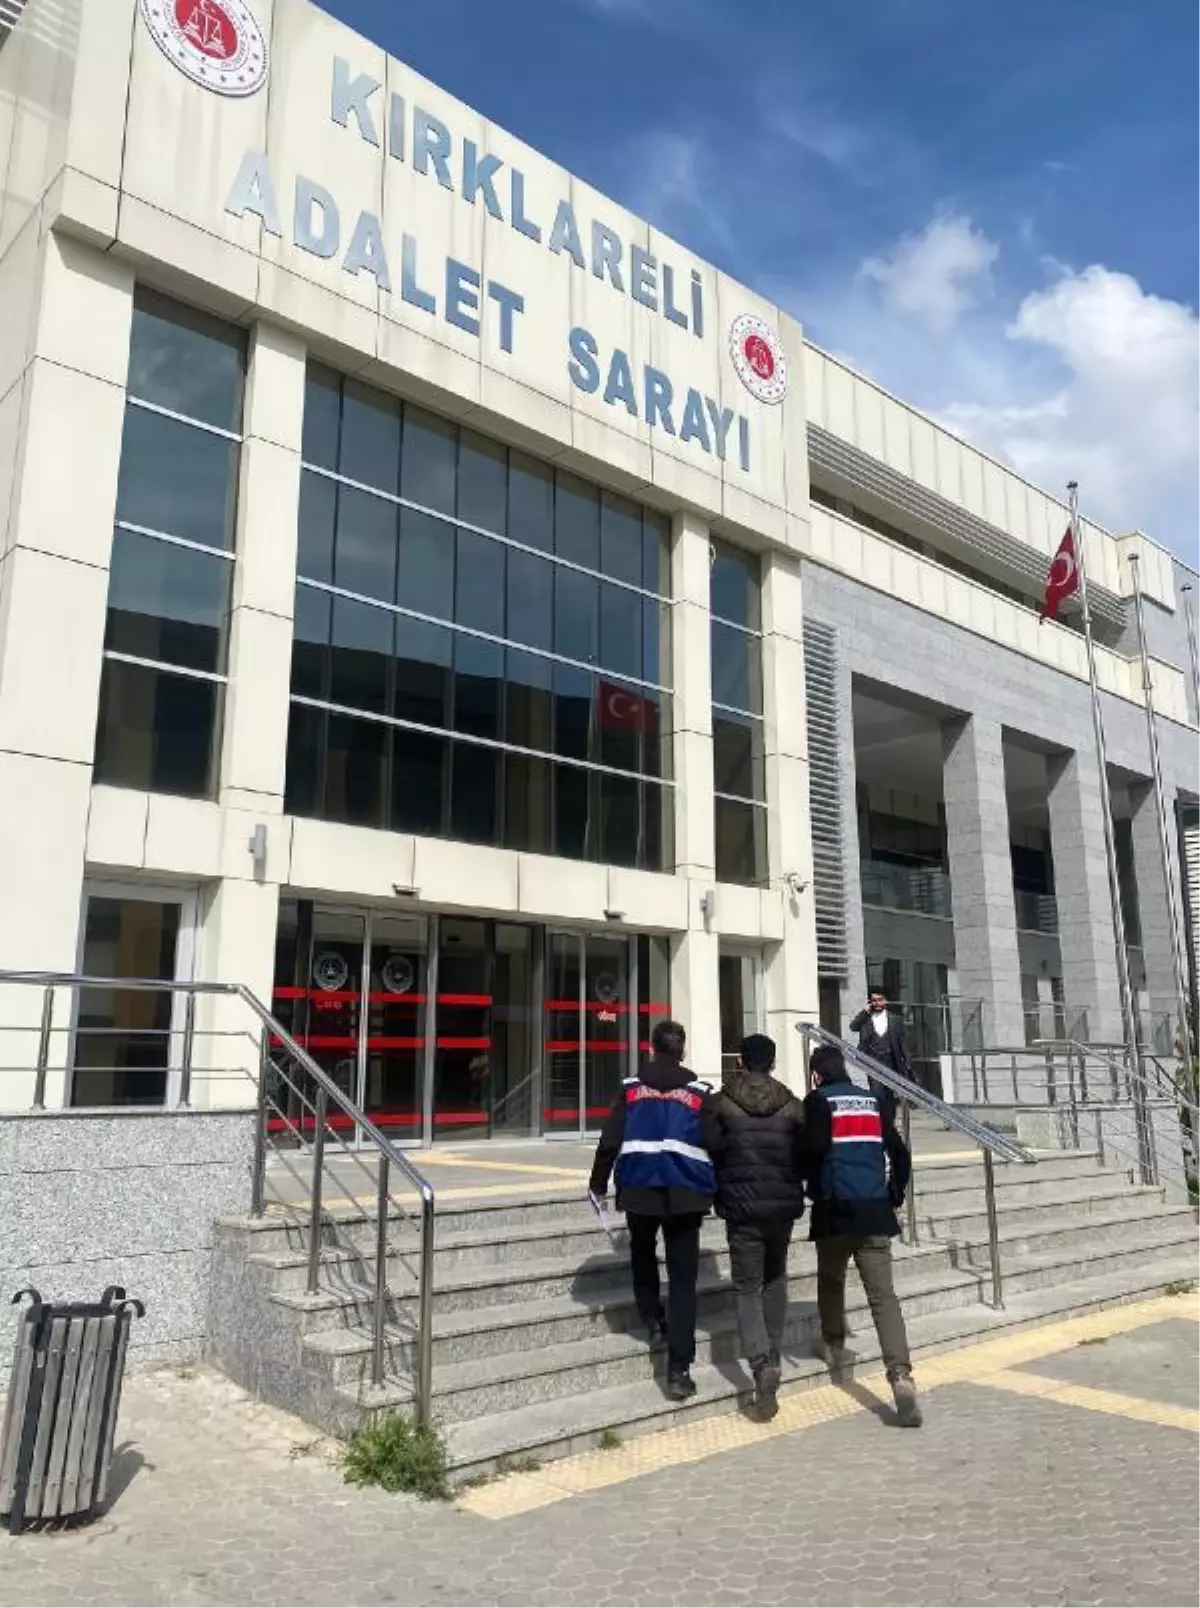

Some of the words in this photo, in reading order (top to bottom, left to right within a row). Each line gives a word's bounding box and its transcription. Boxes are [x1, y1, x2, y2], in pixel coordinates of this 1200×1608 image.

[224, 148, 524, 354] ADALET
[567, 326, 750, 471] SARAYI
[331, 56, 703, 338] KIRKLARELİ
